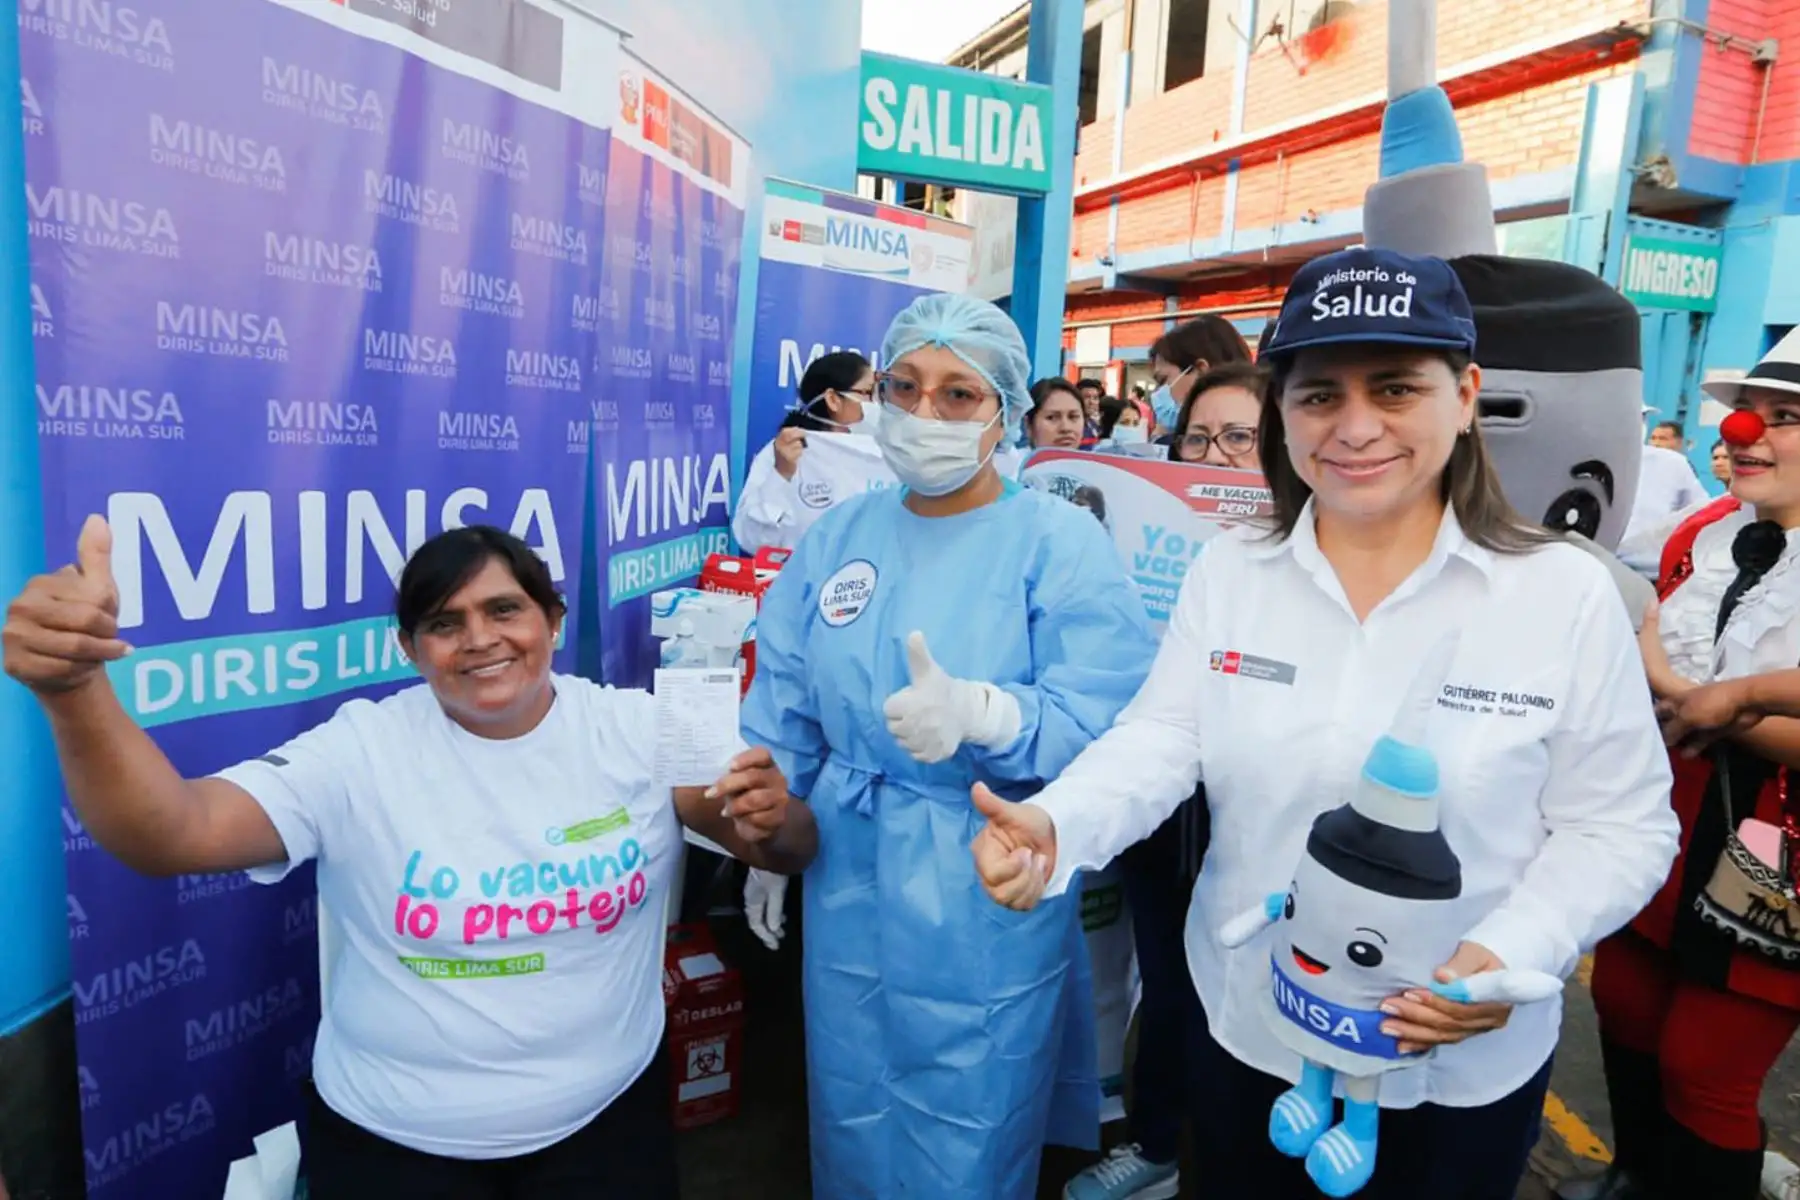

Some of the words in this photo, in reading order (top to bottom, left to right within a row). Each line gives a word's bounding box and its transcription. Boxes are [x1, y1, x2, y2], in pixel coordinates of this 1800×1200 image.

[22, 0, 173, 55] INSA
[261, 56, 384, 120] MINSA
[148, 113, 286, 178] MINSA
[441, 118, 529, 172] MINSA
[863, 76, 1046, 172] SALIDA
[362, 168, 459, 220] MINSA
[140, 242, 181, 260] SUR
[264, 231, 383, 280] MINSA
[511, 212, 588, 257] MINSA
[825, 216, 911, 260] MINSA
[440, 265, 525, 308] MINSA
[1395, 271, 1417, 286] de
[1628, 247, 1718, 299] INGRESO
[156, 301, 288, 346] MINSA
[1311, 284, 1413, 321] Salud
[156, 334, 204, 354] DIRIS
[208, 341, 252, 358] LIMA
[255, 345, 289, 362] SUR
[364, 328, 458, 366] MINSA
[505, 349, 582, 381] MINSA
[94, 422, 144, 440] LIMA
[148, 425, 185, 441] SUR
[266, 399, 379, 432] MINSA
[438, 411, 520, 440] MINSA
[1223, 488, 1273, 502] VACUN
[660, 541, 700, 579] LIMA
[700, 533, 729, 559] UR
[1142, 525, 1186, 557] Yo
[834, 579, 868, 594] DIRIS
[134, 640, 319, 714] DIRIS
[335, 627, 411, 680] LIM
[1500, 692, 1555, 711] PALOMINO
[403, 849, 460, 899] Lo
[394, 893, 440, 940] lo
[462, 871, 647, 945] protejo
[455, 961, 500, 976] LIMA
[504, 955, 542, 974] SUR
[184, 977, 302, 1047] MINSA
